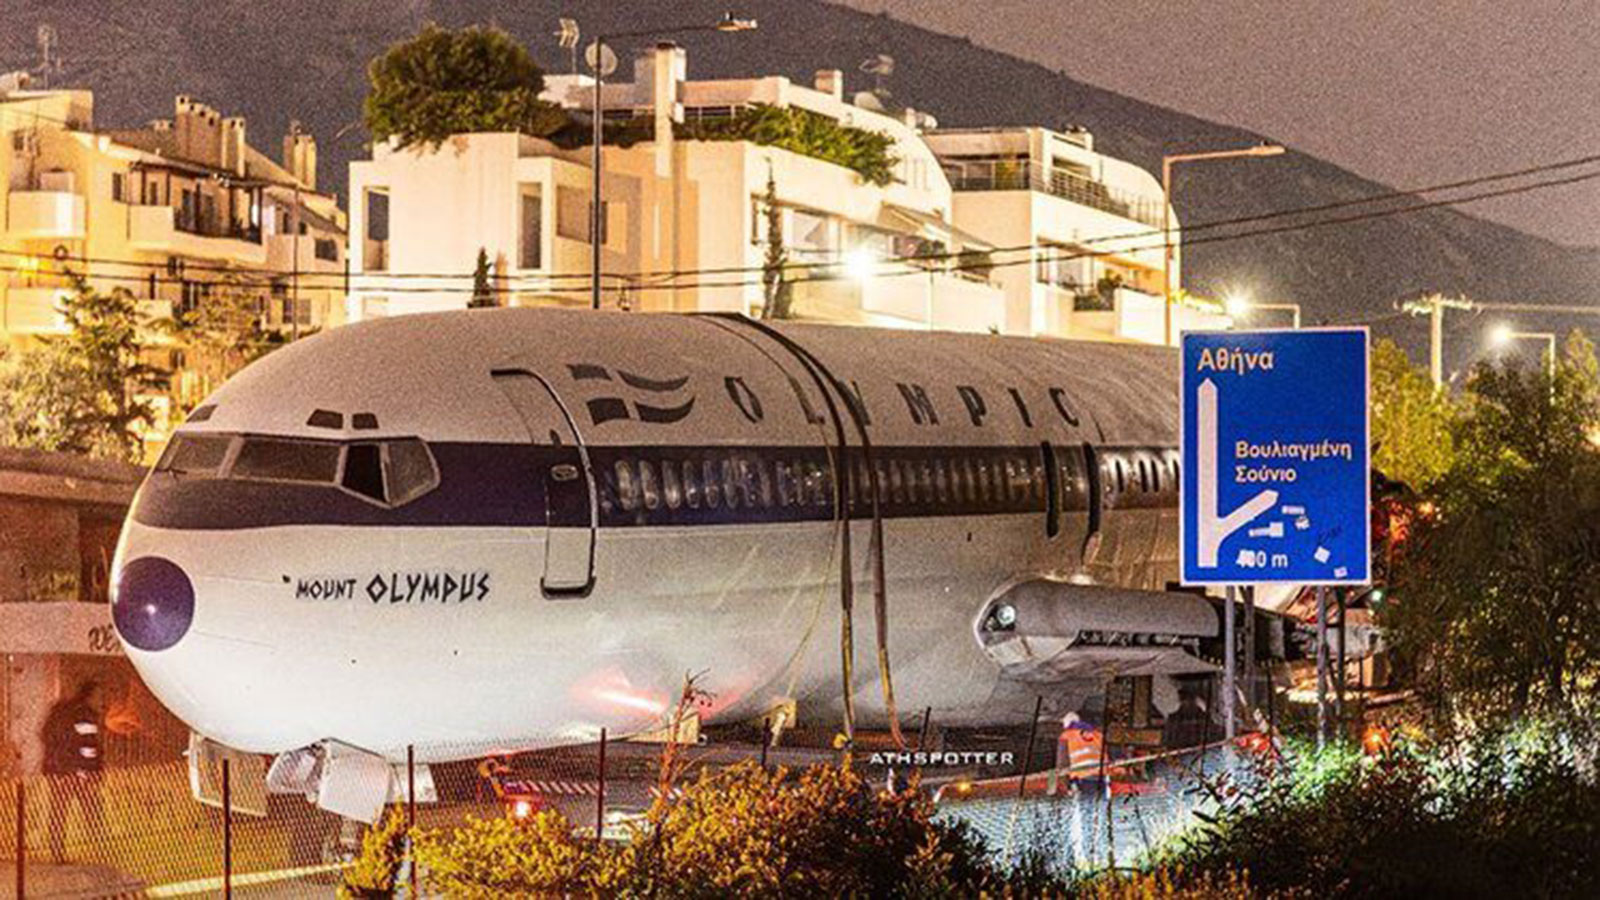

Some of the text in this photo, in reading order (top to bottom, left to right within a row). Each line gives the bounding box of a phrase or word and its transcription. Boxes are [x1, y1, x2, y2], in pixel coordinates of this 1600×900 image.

[1197, 348, 1273, 374] Αθήνα
[724, 375, 1079, 428] OLYMPIC
[1235, 440, 1352, 460] Βουλιαγμένη
[1235, 465, 1297, 482] Σούνιο
[1271, 553, 1288, 568] m
[296, 573, 491, 603] MOUNT OLYMPUS
